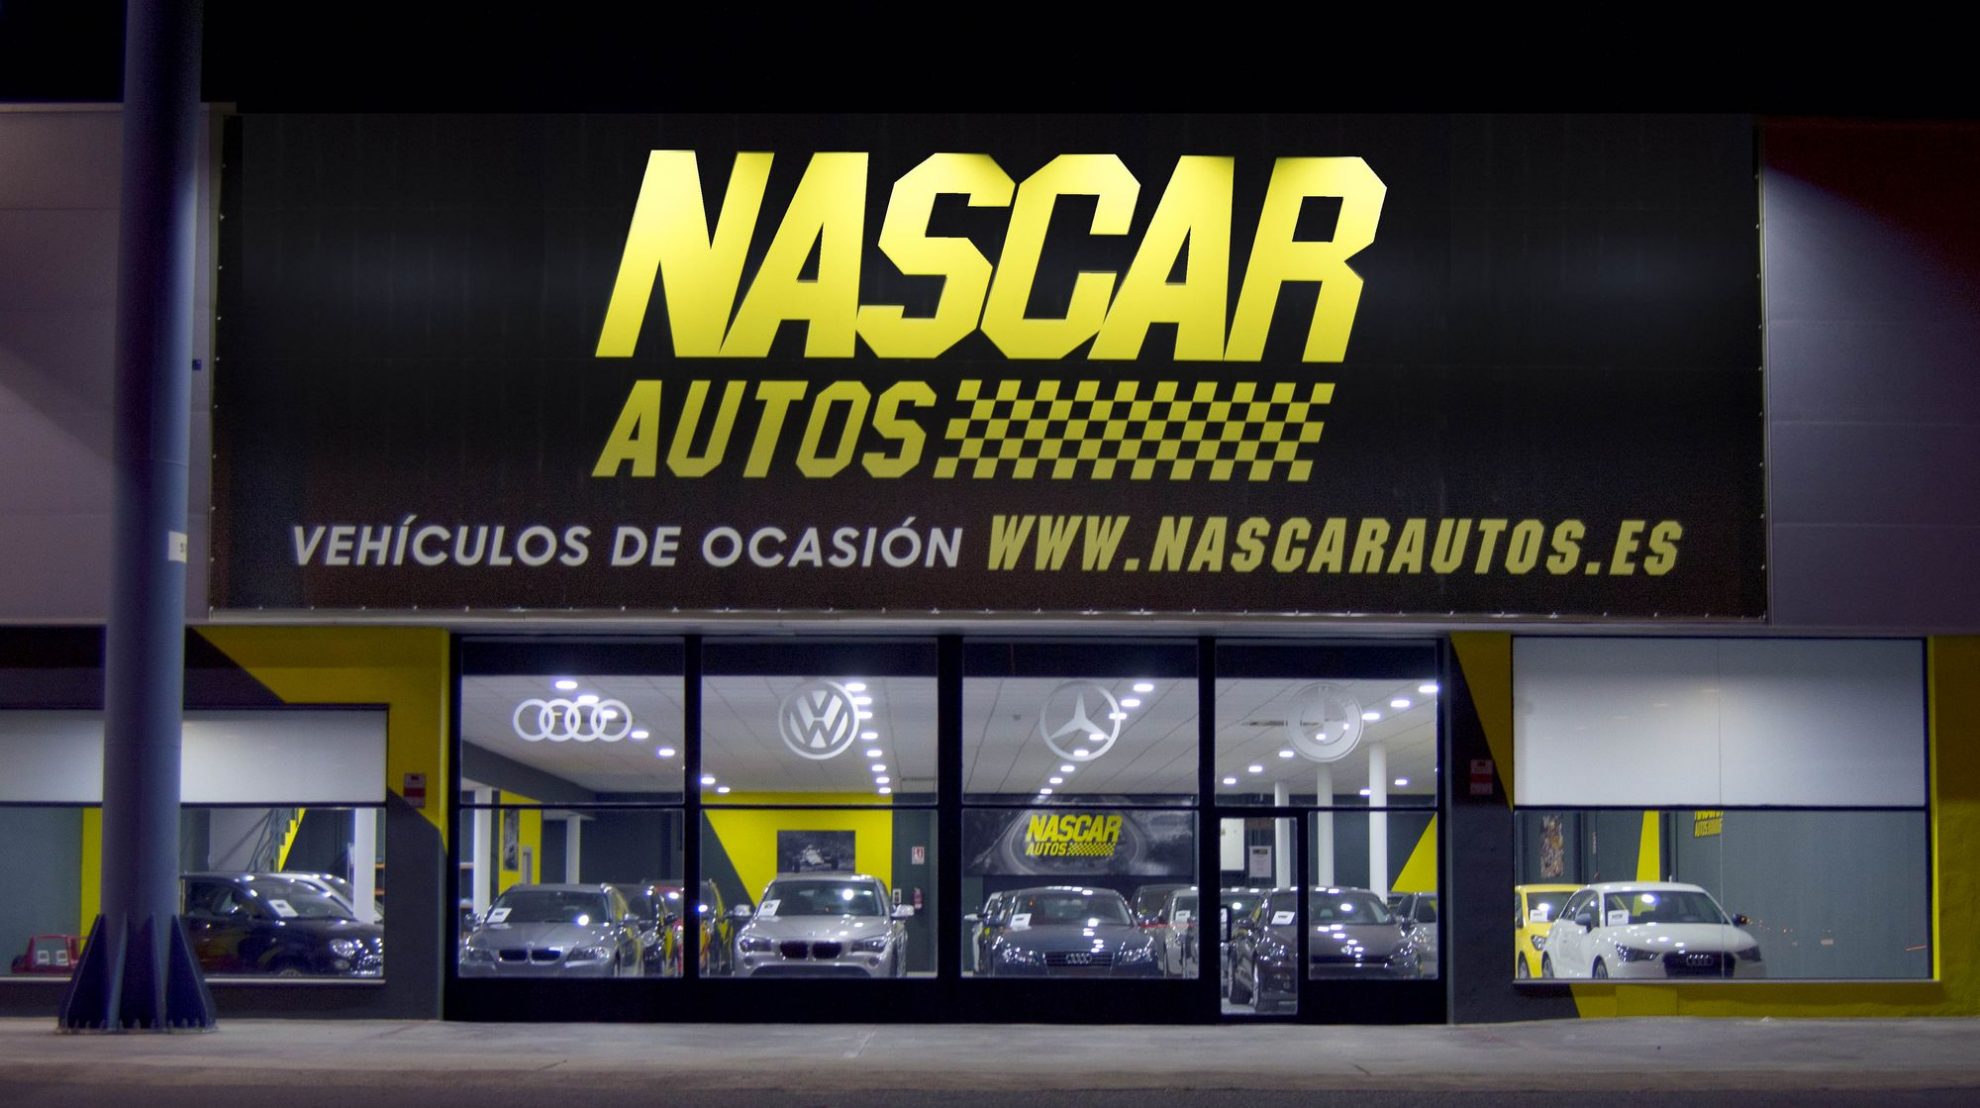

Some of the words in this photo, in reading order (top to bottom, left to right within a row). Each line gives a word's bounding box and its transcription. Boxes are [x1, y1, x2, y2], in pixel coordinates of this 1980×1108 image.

[595, 150, 1388, 363] NASCAR
[592, 379, 938, 479] AUTOS
[293, 514, 592, 567] VEHÍCULOS
[610, 526, 682, 567] DE
[701, 516, 963, 568] OCASIÓN
[987, 514, 1684, 576] WWW.NASCARAUTOS.ES
[1025, 814, 1123, 843] NASCAR
[1025, 843, 1068, 856] AUTOS
